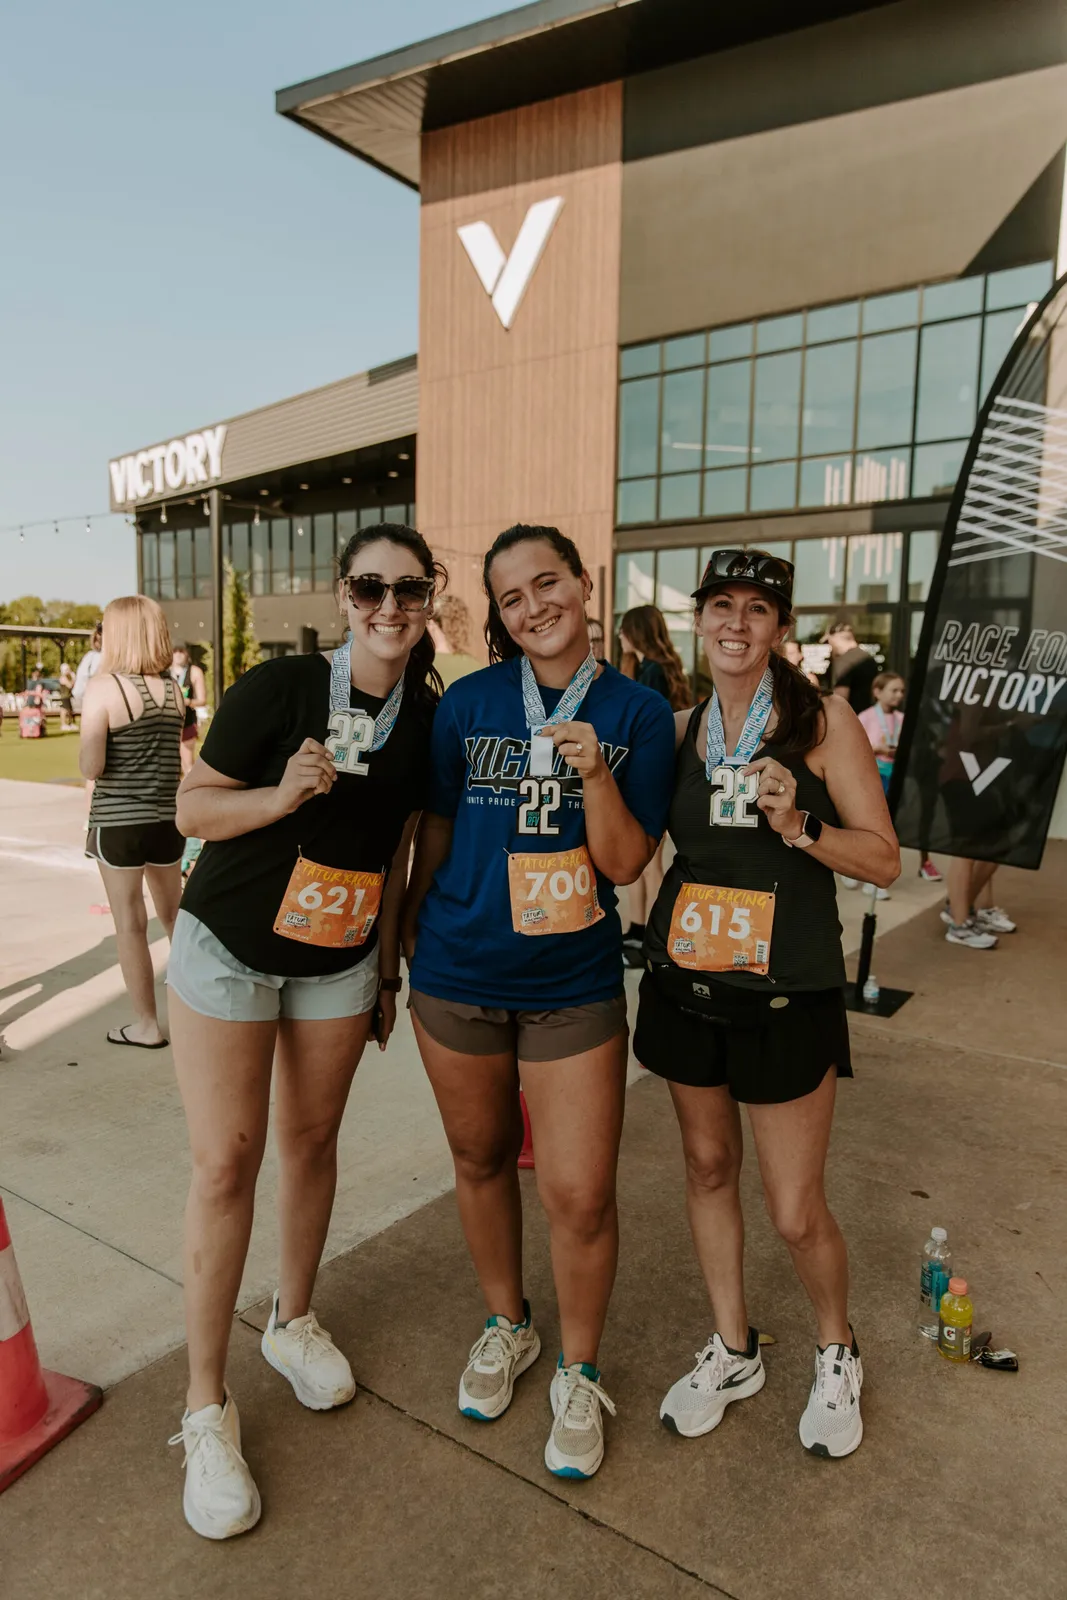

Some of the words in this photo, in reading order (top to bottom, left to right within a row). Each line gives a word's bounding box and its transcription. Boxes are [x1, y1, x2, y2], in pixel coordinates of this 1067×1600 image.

[109, 424, 228, 504] VICTORY
[934, 619, 1019, 669] RACE
[1018, 629, 1067, 676] FO
[557, 681, 585, 716] VICTORY
[939, 663, 1067, 716] VICTORY
[352, 731, 362, 741] 5K
[738, 711, 765, 751] VICTORY
[754, 698, 769, 713] 5K
[325, 711, 375, 776] 22
[465, 737, 629, 778] VICY
[466, 795, 484, 805] IGNITE
[488, 797, 516, 807] PRIDE
[518, 777, 562, 835] 22
[542, 795, 551, 804] 5K
[711, 766, 759, 827] 22
[302, 862, 341, 882] TATUR
[518, 856, 557, 870] TATUR
[297, 881, 366, 916] 621
[525, 864, 590, 901] 700
[682, 885, 715, 900] TATUR
[717, 888, 767, 911] RACING
[287, 914, 306, 923] TATUR
[523, 910, 541, 920] TATUR
[680, 901, 751, 940] 615
[943, 1326, 956, 1340] G
